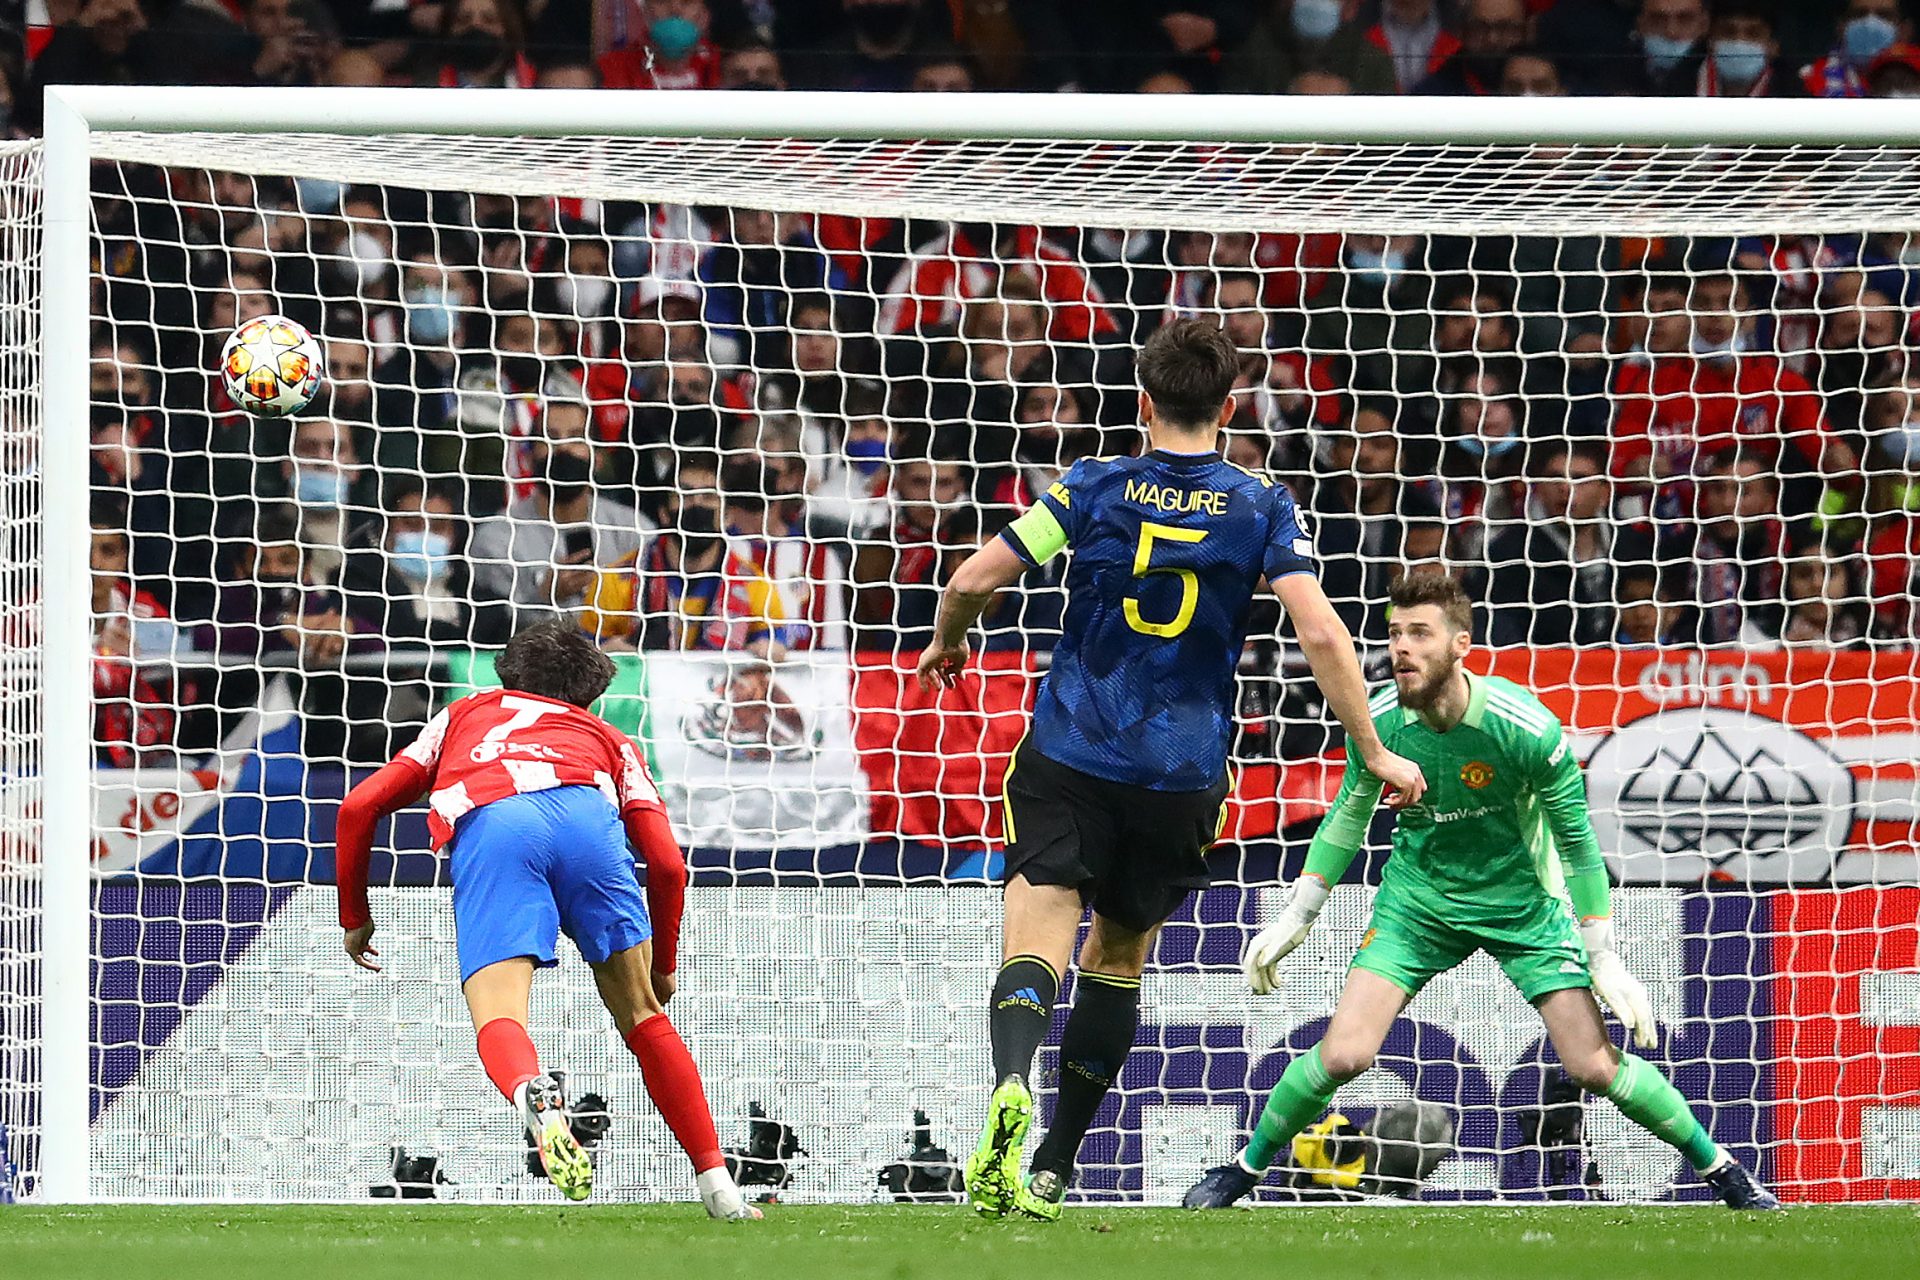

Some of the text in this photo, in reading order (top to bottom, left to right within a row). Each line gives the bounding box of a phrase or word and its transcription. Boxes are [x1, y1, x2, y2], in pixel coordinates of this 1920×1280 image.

[1124, 479, 1229, 516] MAGUIRE
[1122, 521, 1209, 638] 5
[1638, 652, 1771, 704] atm
[482, 694, 570, 741] 7
[997, 996, 1046, 1016] adidas
